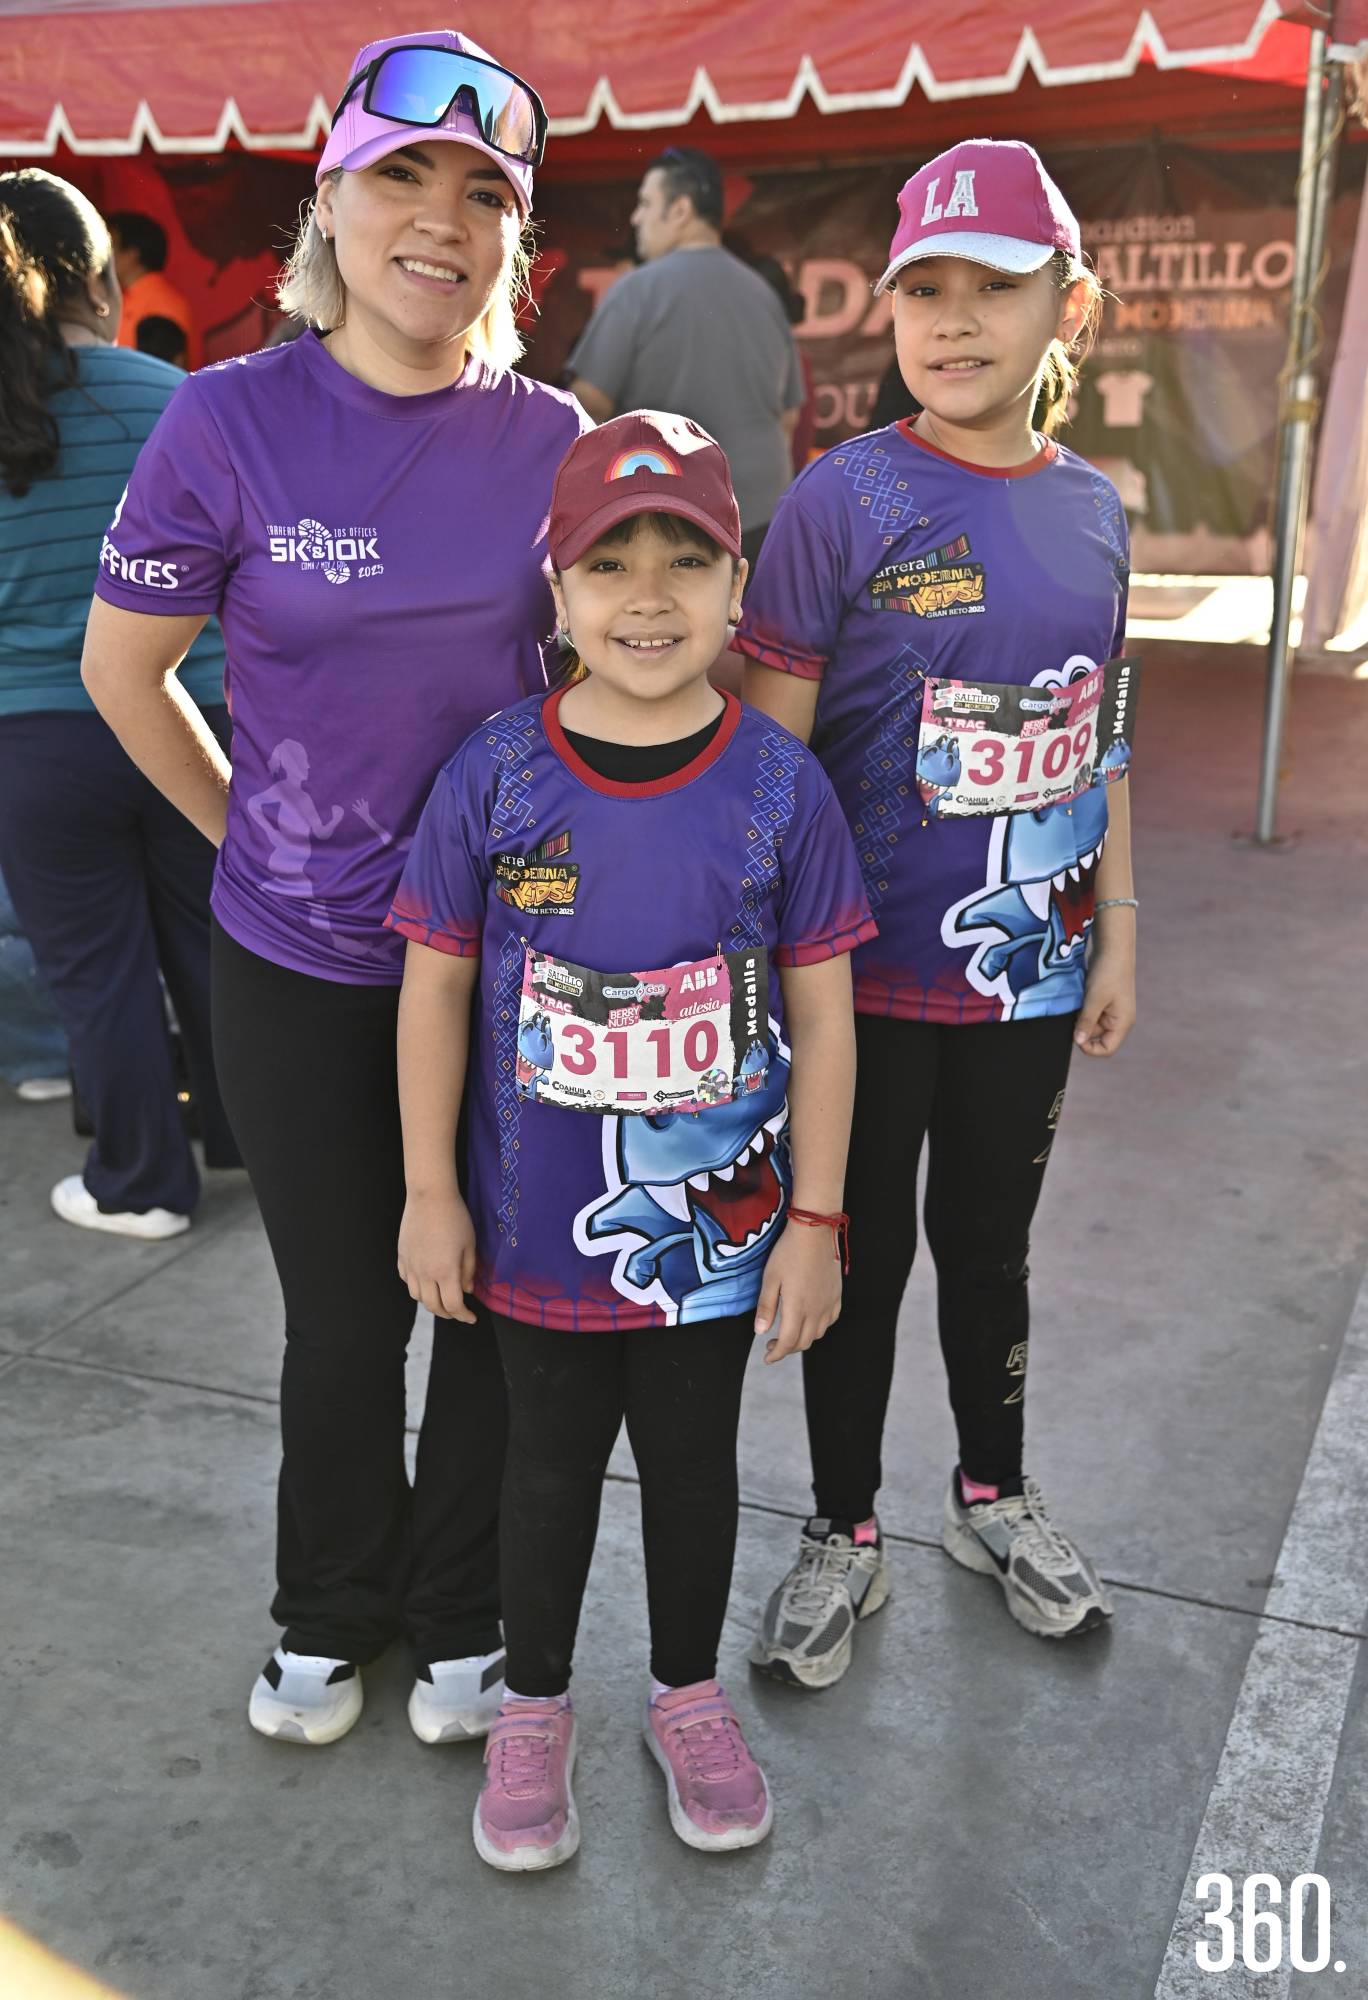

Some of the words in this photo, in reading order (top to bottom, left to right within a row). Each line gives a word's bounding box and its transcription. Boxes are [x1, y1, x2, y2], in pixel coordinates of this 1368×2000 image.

[920, 169, 979, 227] LA
[1097, 240, 1295, 290] ALTILLO
[349, 526, 378, 538] OFFICES
[357, 563, 385, 579] 2025
[896, 567, 975, 590] MODERNA
[925, 610, 948, 619] GRAN
[948, 608, 969, 616] RETO
[967, 605, 986, 614] 2025
[954, 692, 999, 705] SALTILLO
[1021, 699, 1049, 711] Cargo
[1112, 665, 1132, 736] Medalla
[967, 721, 1093, 787] 3109
[558, 907, 575, 916] 2025
[547, 968, 584, 989] SALTILLO
[679, 966, 719, 994] ABB
[604, 988, 636, 999] Cargo
[646, 984, 665, 994] Gas
[743, 957, 759, 1037] Medalla
[610, 1006, 641, 1020] BERRY
[608, 1016, 636, 1029] NUTS
[559, 1018, 720, 1080] 3110
